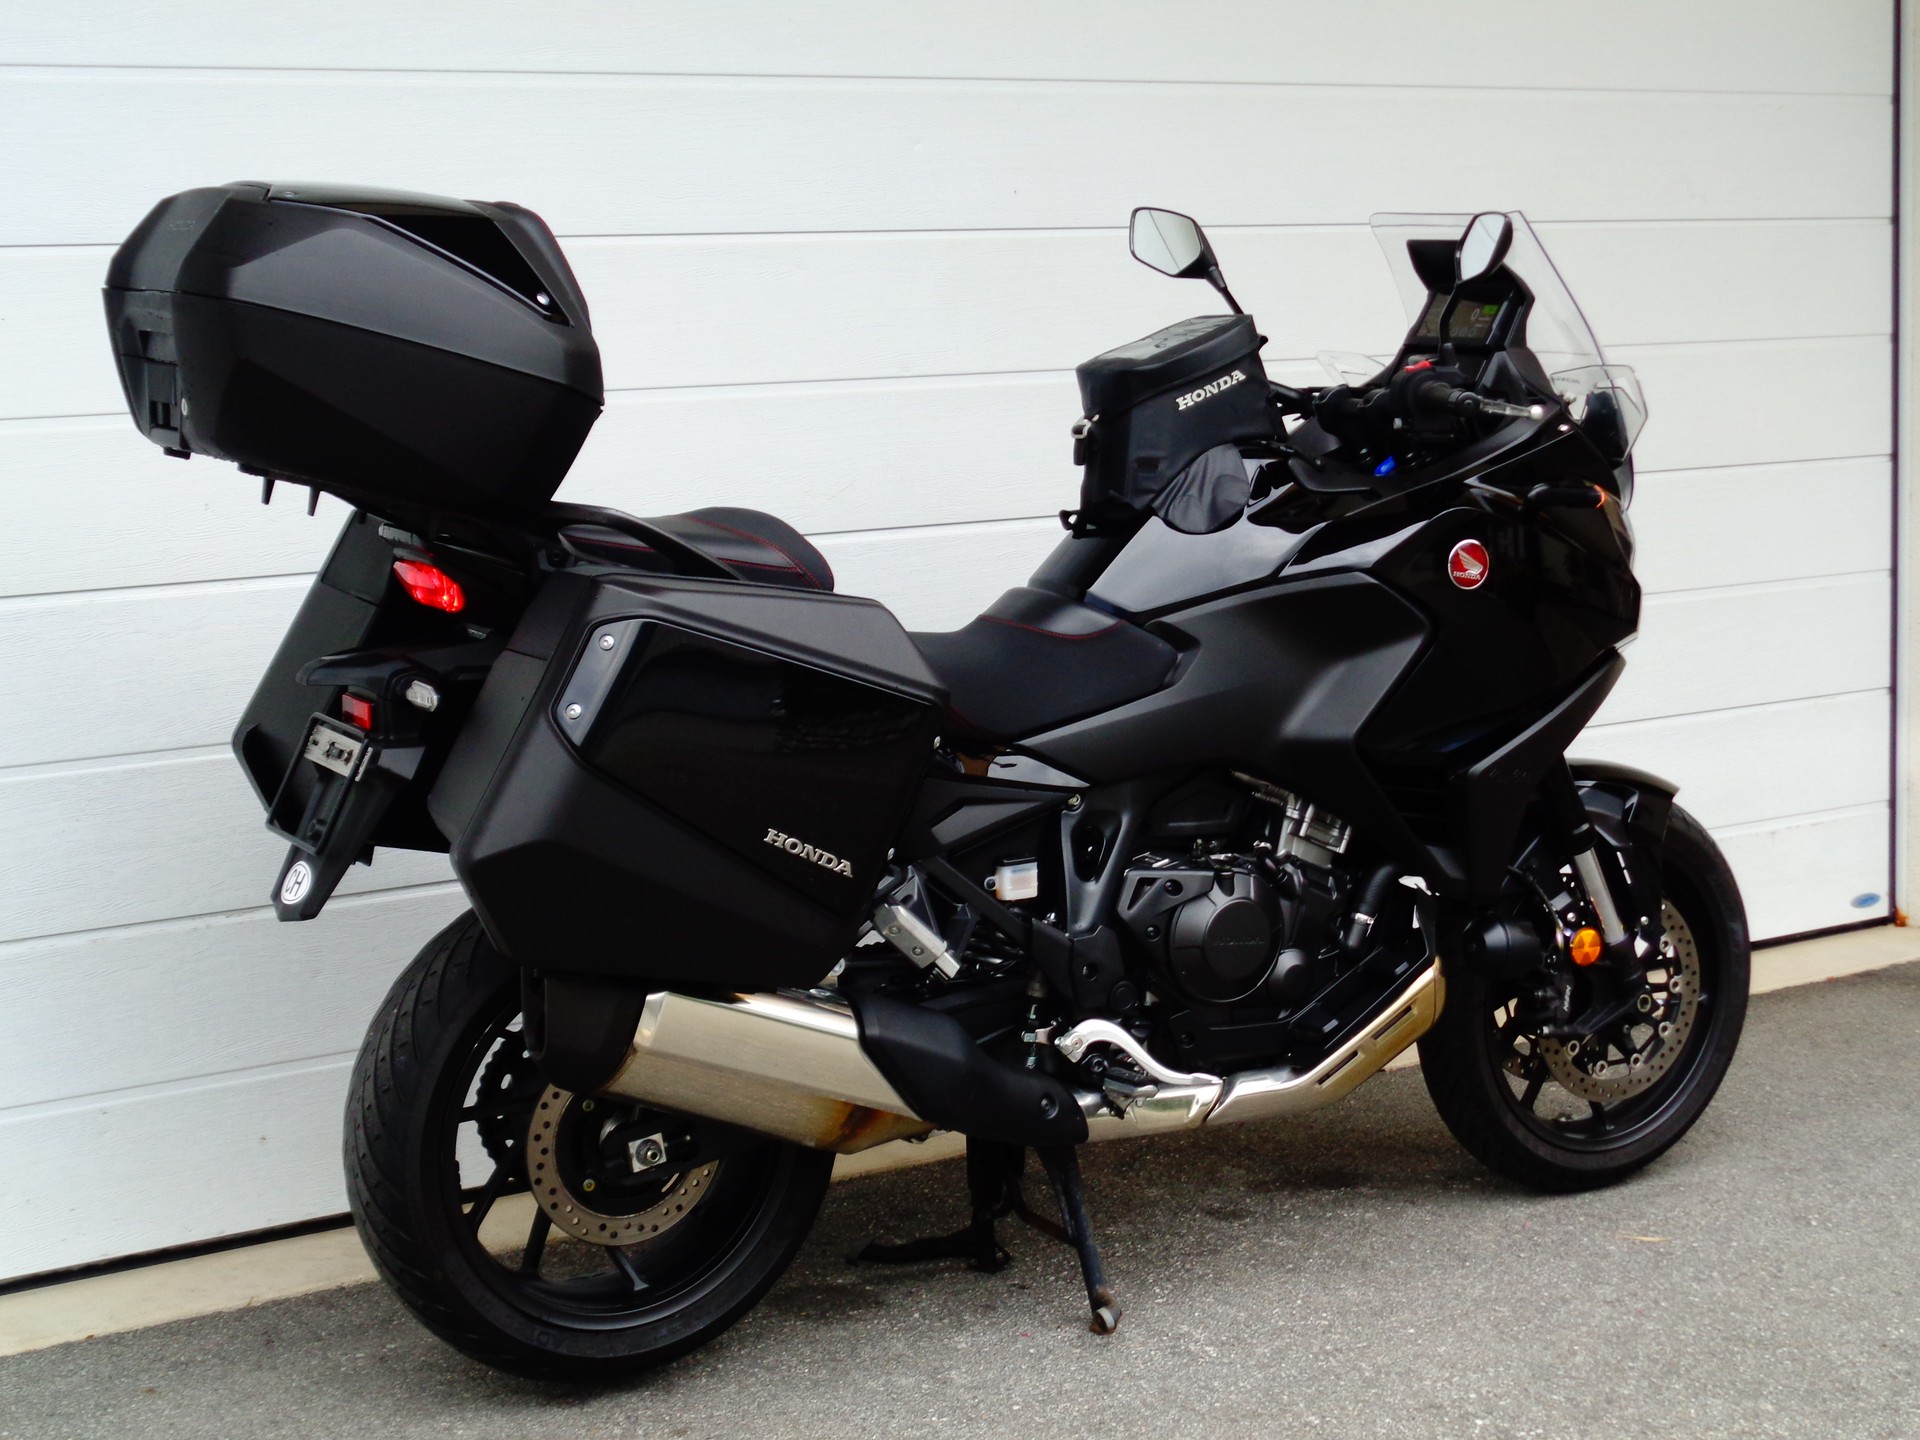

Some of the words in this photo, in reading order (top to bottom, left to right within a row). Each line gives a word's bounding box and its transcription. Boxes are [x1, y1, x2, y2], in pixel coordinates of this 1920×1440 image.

[1175, 369, 1247, 411] HONDA
[1452, 570, 1482, 581] HONDA
[763, 828, 854, 878] HONDA
[285, 868, 307, 898] CH
